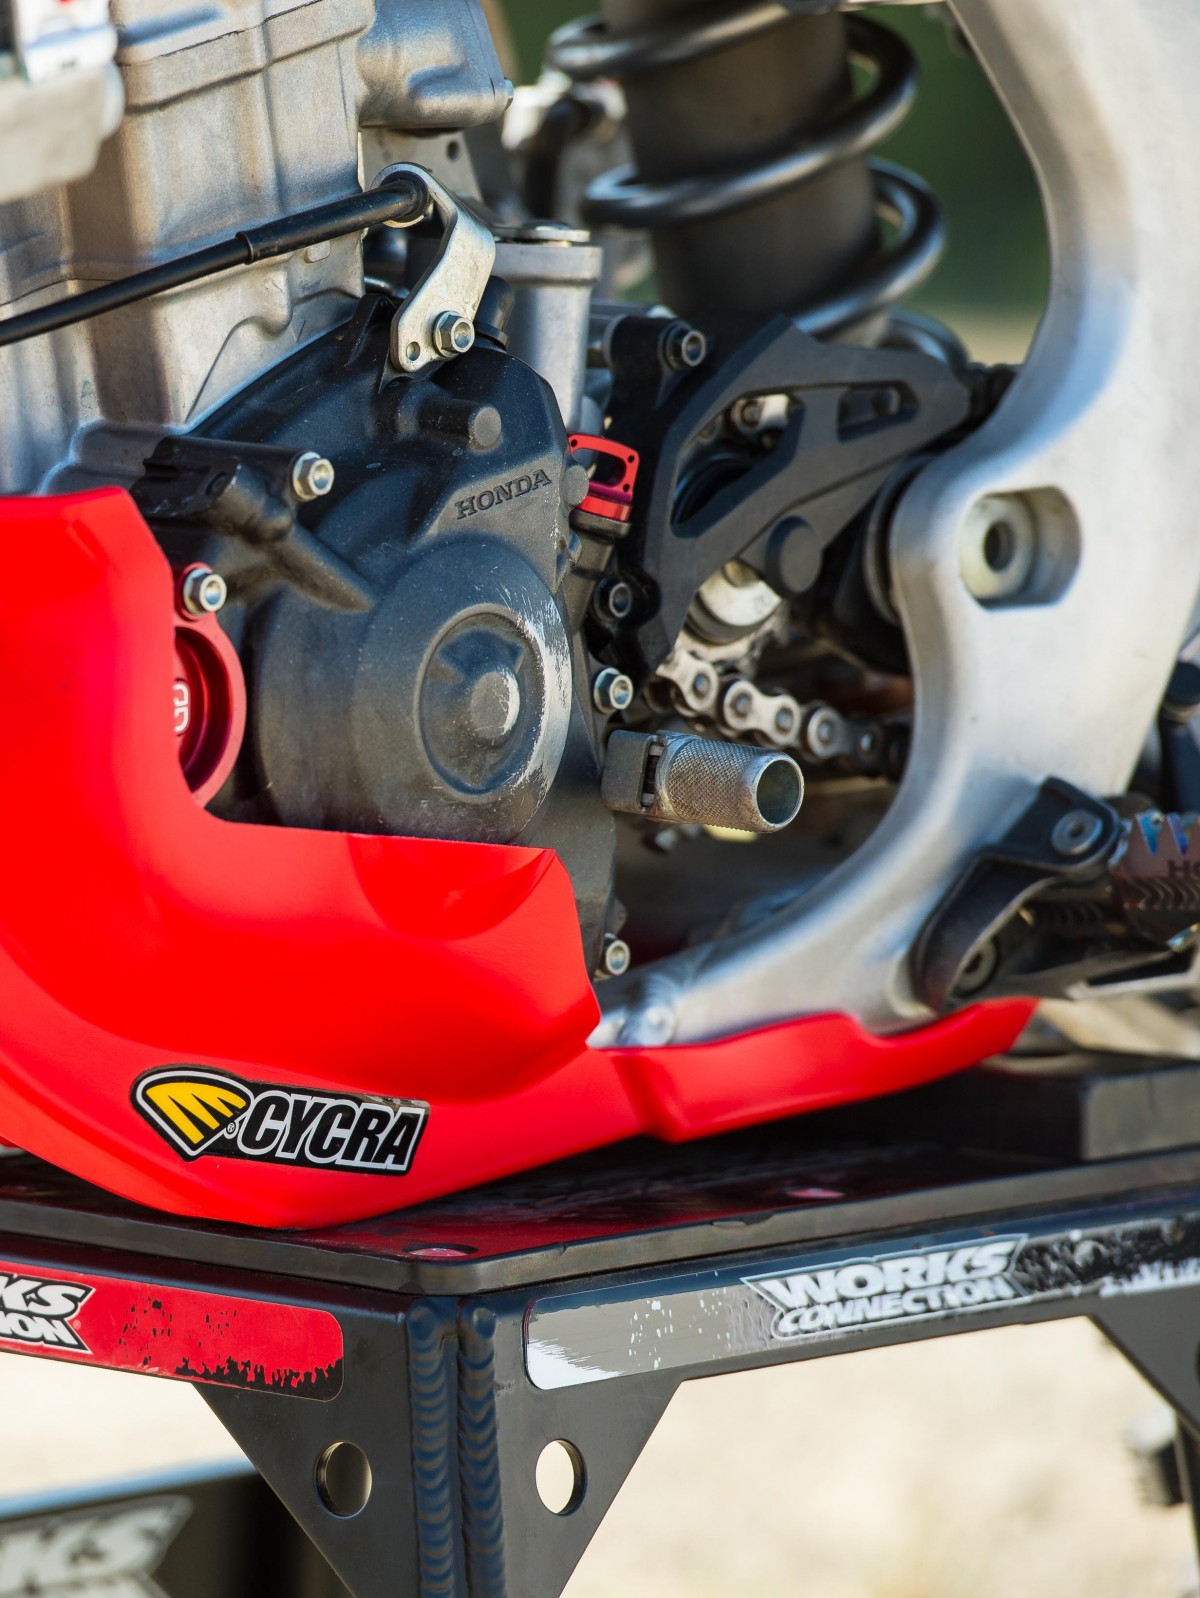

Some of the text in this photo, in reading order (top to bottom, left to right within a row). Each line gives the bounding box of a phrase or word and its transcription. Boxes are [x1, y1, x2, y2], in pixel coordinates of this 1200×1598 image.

[454, 468, 553, 520] HONDA
[237, 1091, 425, 1171] CYCRA
[757, 1240, 1017, 1309] WORKS
[777, 1272, 1016, 1335] CONNECTION
